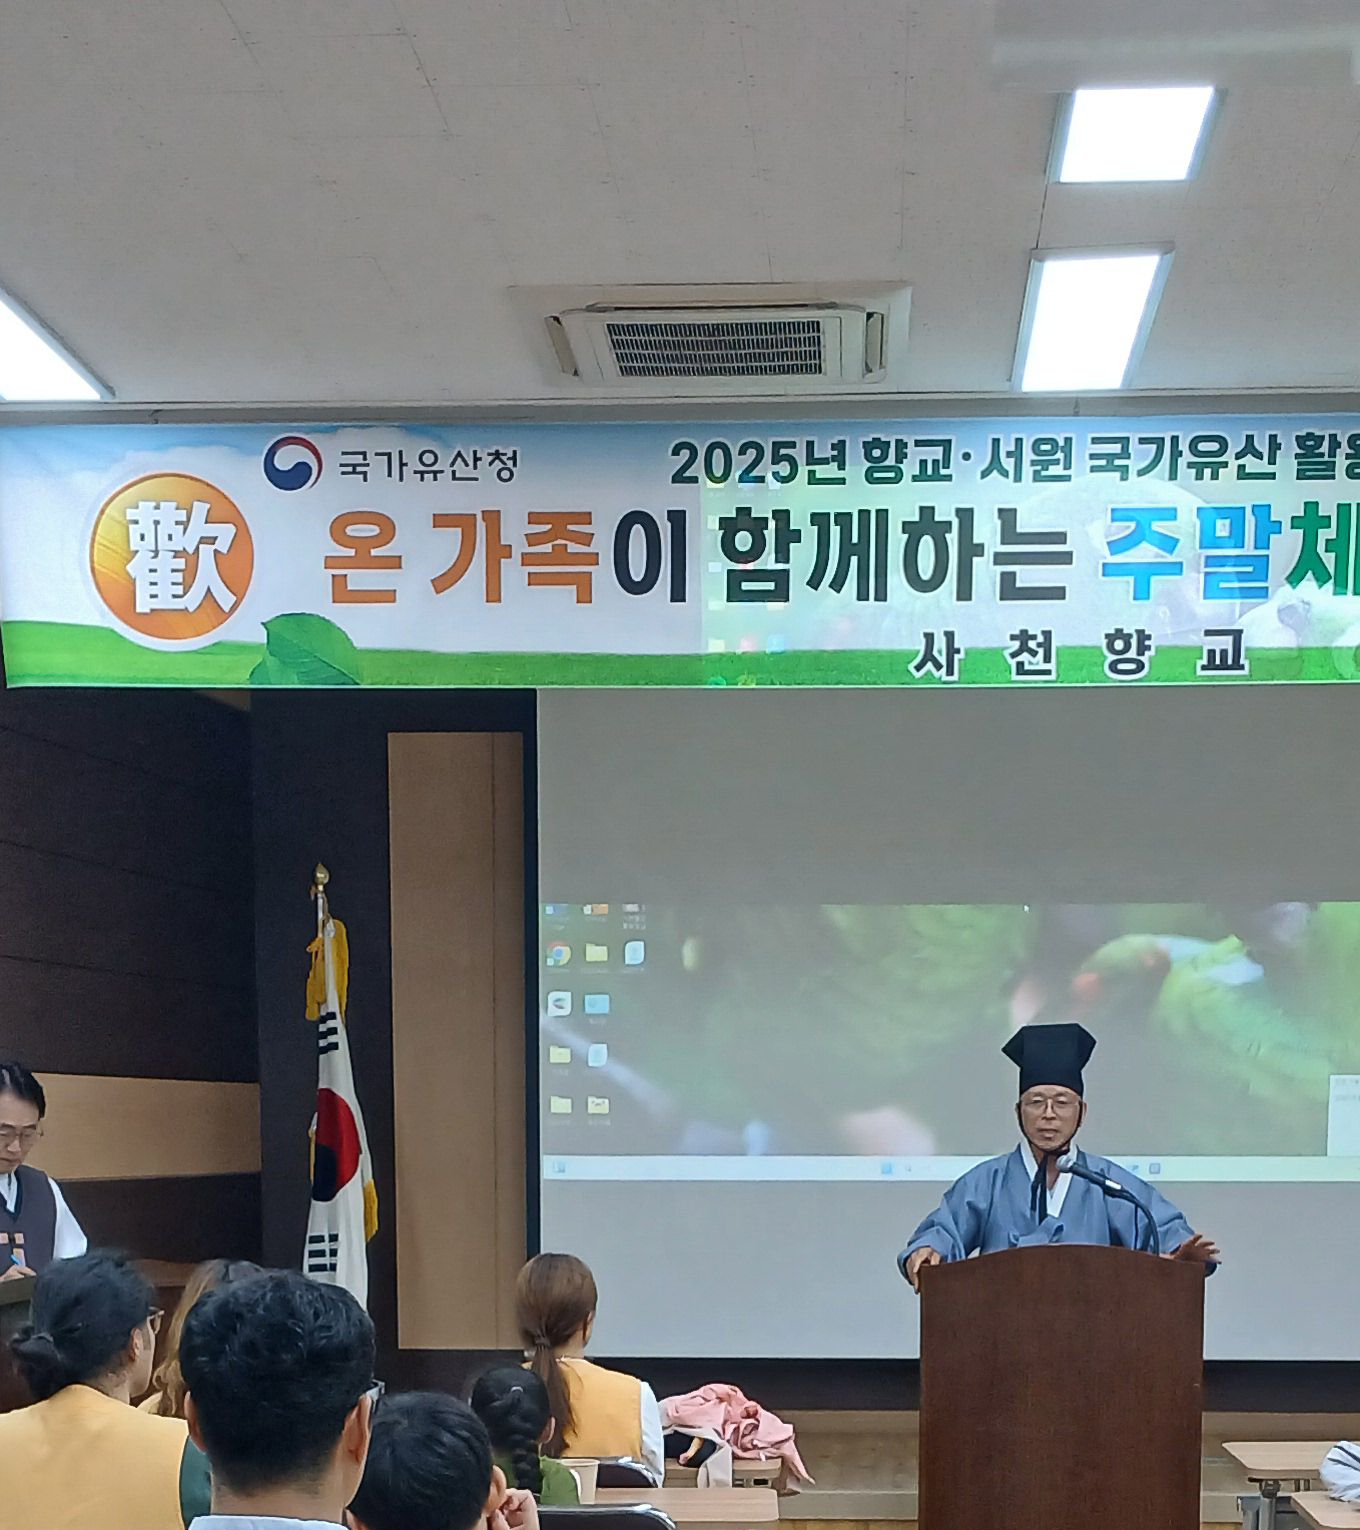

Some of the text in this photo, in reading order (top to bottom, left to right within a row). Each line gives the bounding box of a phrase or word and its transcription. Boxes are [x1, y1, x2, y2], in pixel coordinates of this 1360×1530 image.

[338, 446, 519, 484] 국가유산청
[669, 437, 848, 486] 2025년
[1088, 433, 1282, 482] 국가유산
[127, 500, 237, 614] 歡
[323, 509, 404, 604] 온
[430, 507, 688, 604] 가족이
[717, 503, 1074, 603] 함께하는
